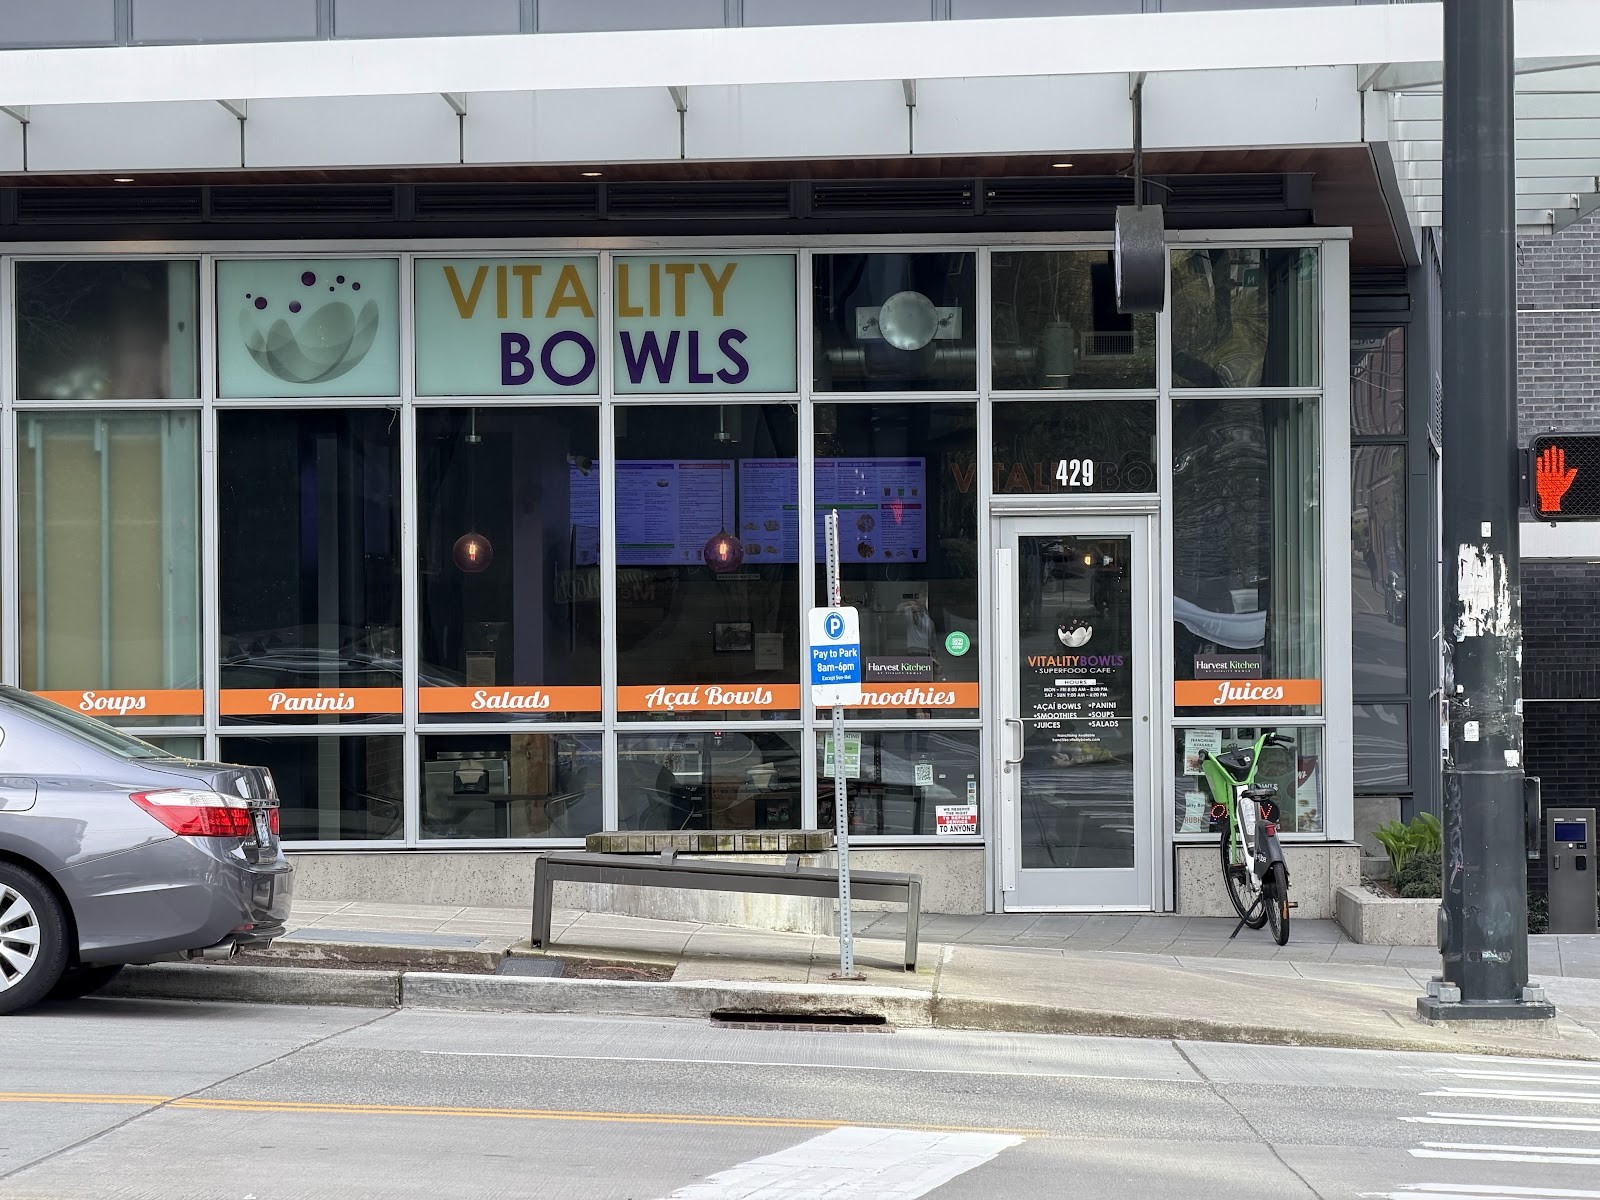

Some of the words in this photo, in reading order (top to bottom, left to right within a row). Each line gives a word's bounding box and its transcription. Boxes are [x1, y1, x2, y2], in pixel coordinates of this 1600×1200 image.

[443, 263, 738, 319] VITALITY
[501, 328, 749, 387] BOWLS
[1056, 459, 1094, 486] 429
[830, 618, 841, 635] P
[813, 649, 827, 661] Pay
[829, 650, 838, 658] to
[839, 648, 858, 658] Park
[817, 662, 855, 674] 8am-6pm
[868, 662, 900, 671] Harvest
[901, 662, 931, 671] Kitchen
[1196, 660, 1228, 670] Harvest
[1229, 660, 1260, 669] Kitchen
[267, 692, 355, 711] Paninis
[470, 690, 551, 710] Salads
[645, 687, 699, 711] Açaí
[704, 686, 773, 706] Bowls
[857, 687, 956, 706] moothies
[1213, 681, 1284, 705] Juices
[78, 691, 147, 715] Soups
[1036, 721, 1061, 729] JUICES
[1091, 720, 1119, 728] SALADS
[939, 825, 948, 833] TO
[950, 824, 975, 832] ANYONE
